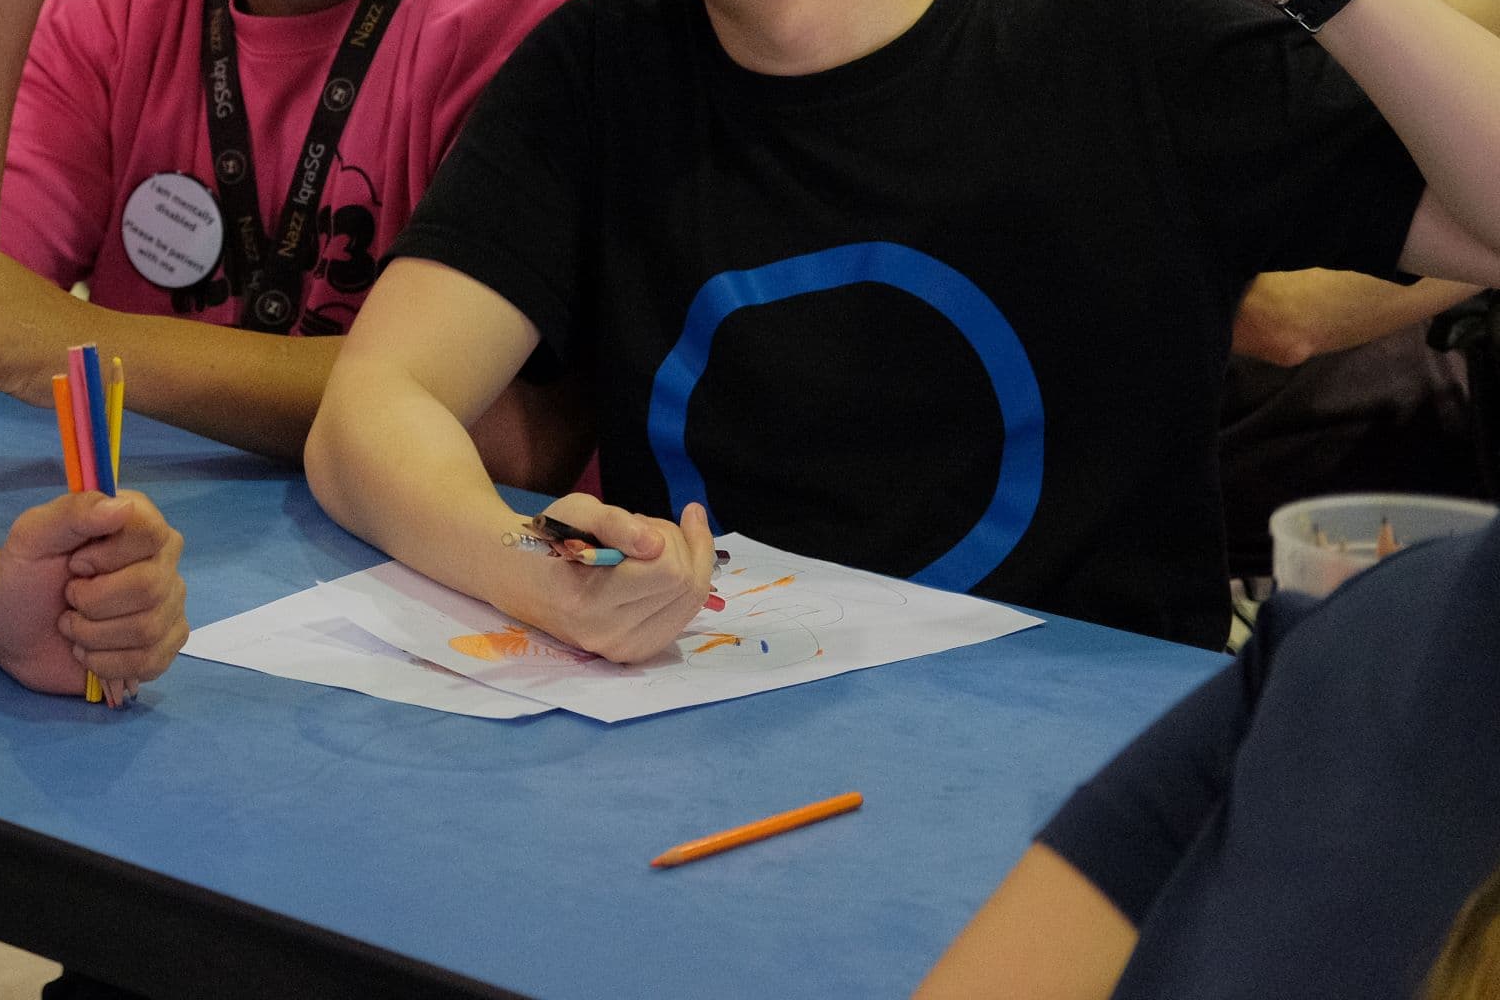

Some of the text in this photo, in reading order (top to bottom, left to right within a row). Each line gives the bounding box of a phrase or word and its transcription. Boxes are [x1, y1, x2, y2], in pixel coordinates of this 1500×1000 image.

[351, 3, 384, 48] Nazz
[278, 143, 326, 258] Nazz IqraSG
